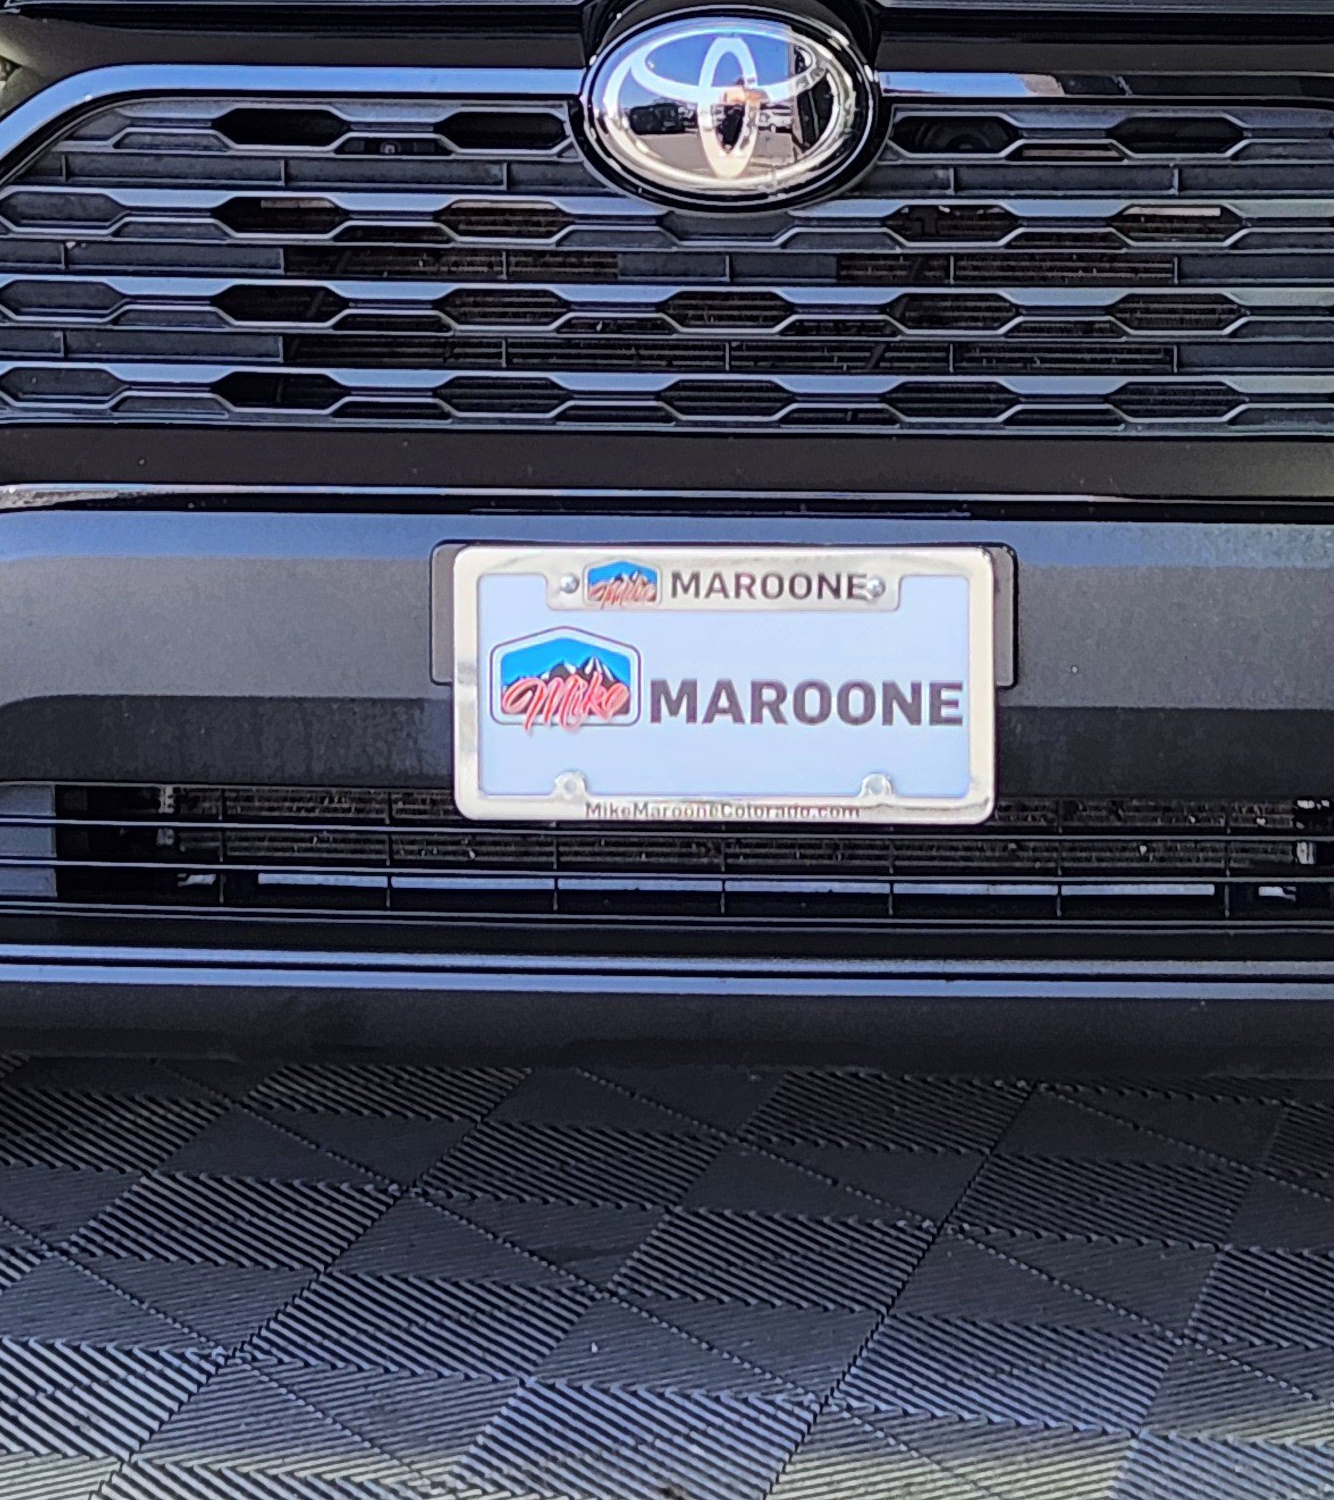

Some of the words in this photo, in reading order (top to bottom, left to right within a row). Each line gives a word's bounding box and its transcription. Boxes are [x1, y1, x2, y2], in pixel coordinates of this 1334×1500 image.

[671, 571, 868, 601] MAROONE
[502, 670, 630, 733] Mike
[650, 678, 964, 726] MAROONE
